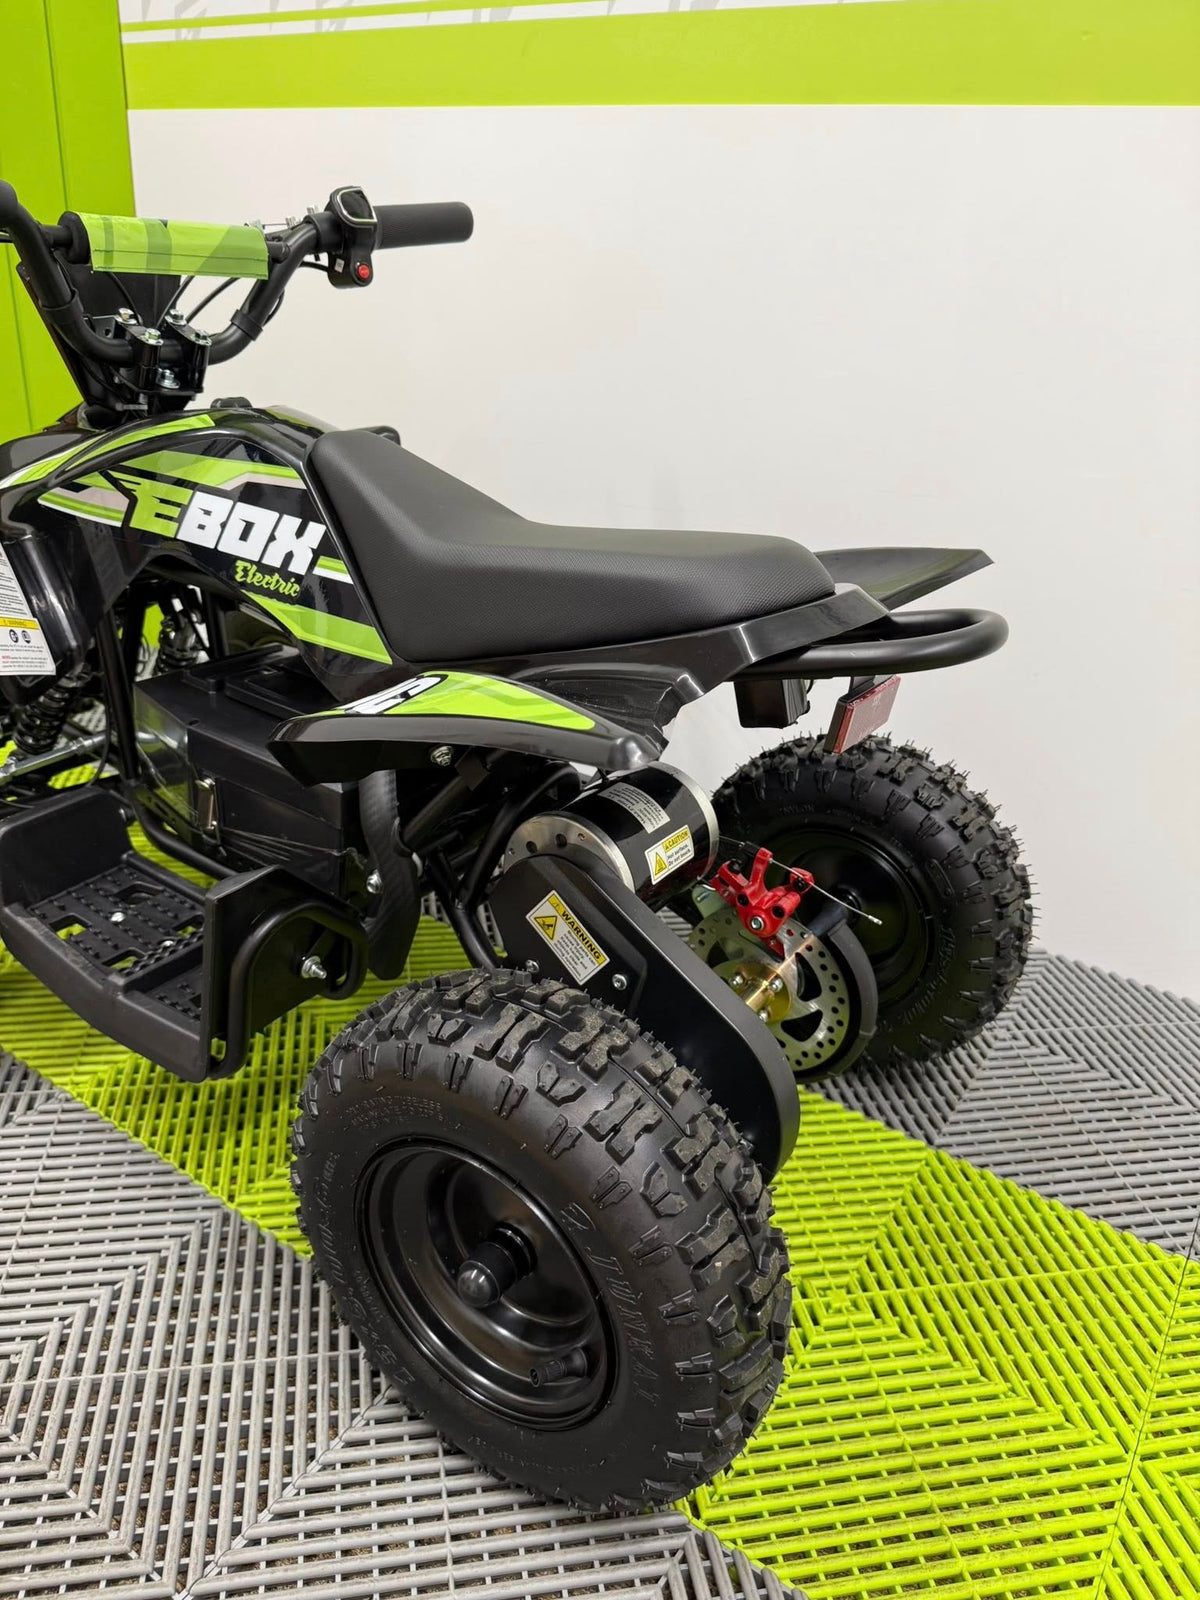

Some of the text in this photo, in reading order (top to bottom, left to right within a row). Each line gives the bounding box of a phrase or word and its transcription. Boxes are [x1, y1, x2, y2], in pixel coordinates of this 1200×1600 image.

[234, 560, 300, 598] Electric
[668, 830, 689, 848] CAUTION
[561, 910, 602, 960] WARNING
